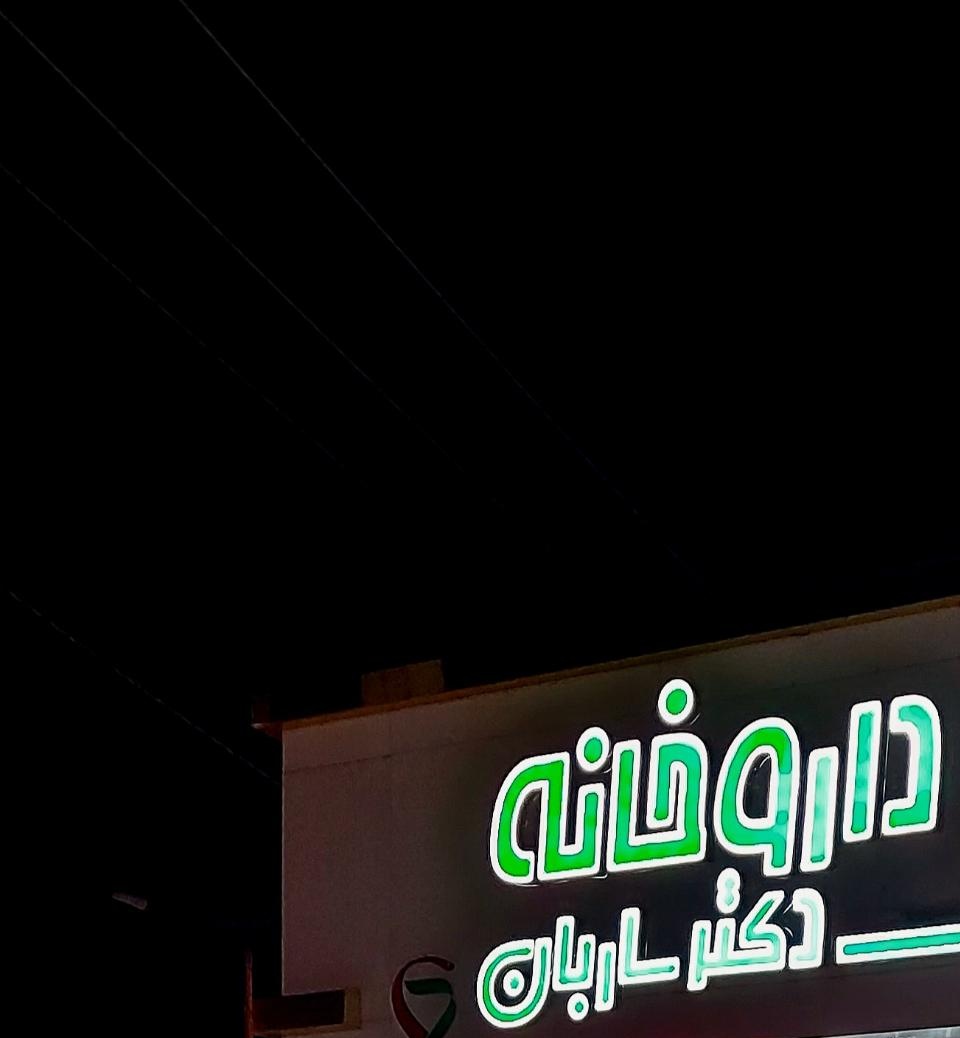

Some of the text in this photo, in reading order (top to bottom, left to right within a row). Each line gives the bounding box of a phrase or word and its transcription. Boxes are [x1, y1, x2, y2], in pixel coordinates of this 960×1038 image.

[489, 678, 942, 884] داروخانه
[477, 867, 825, 1029] دکتر ساربان
